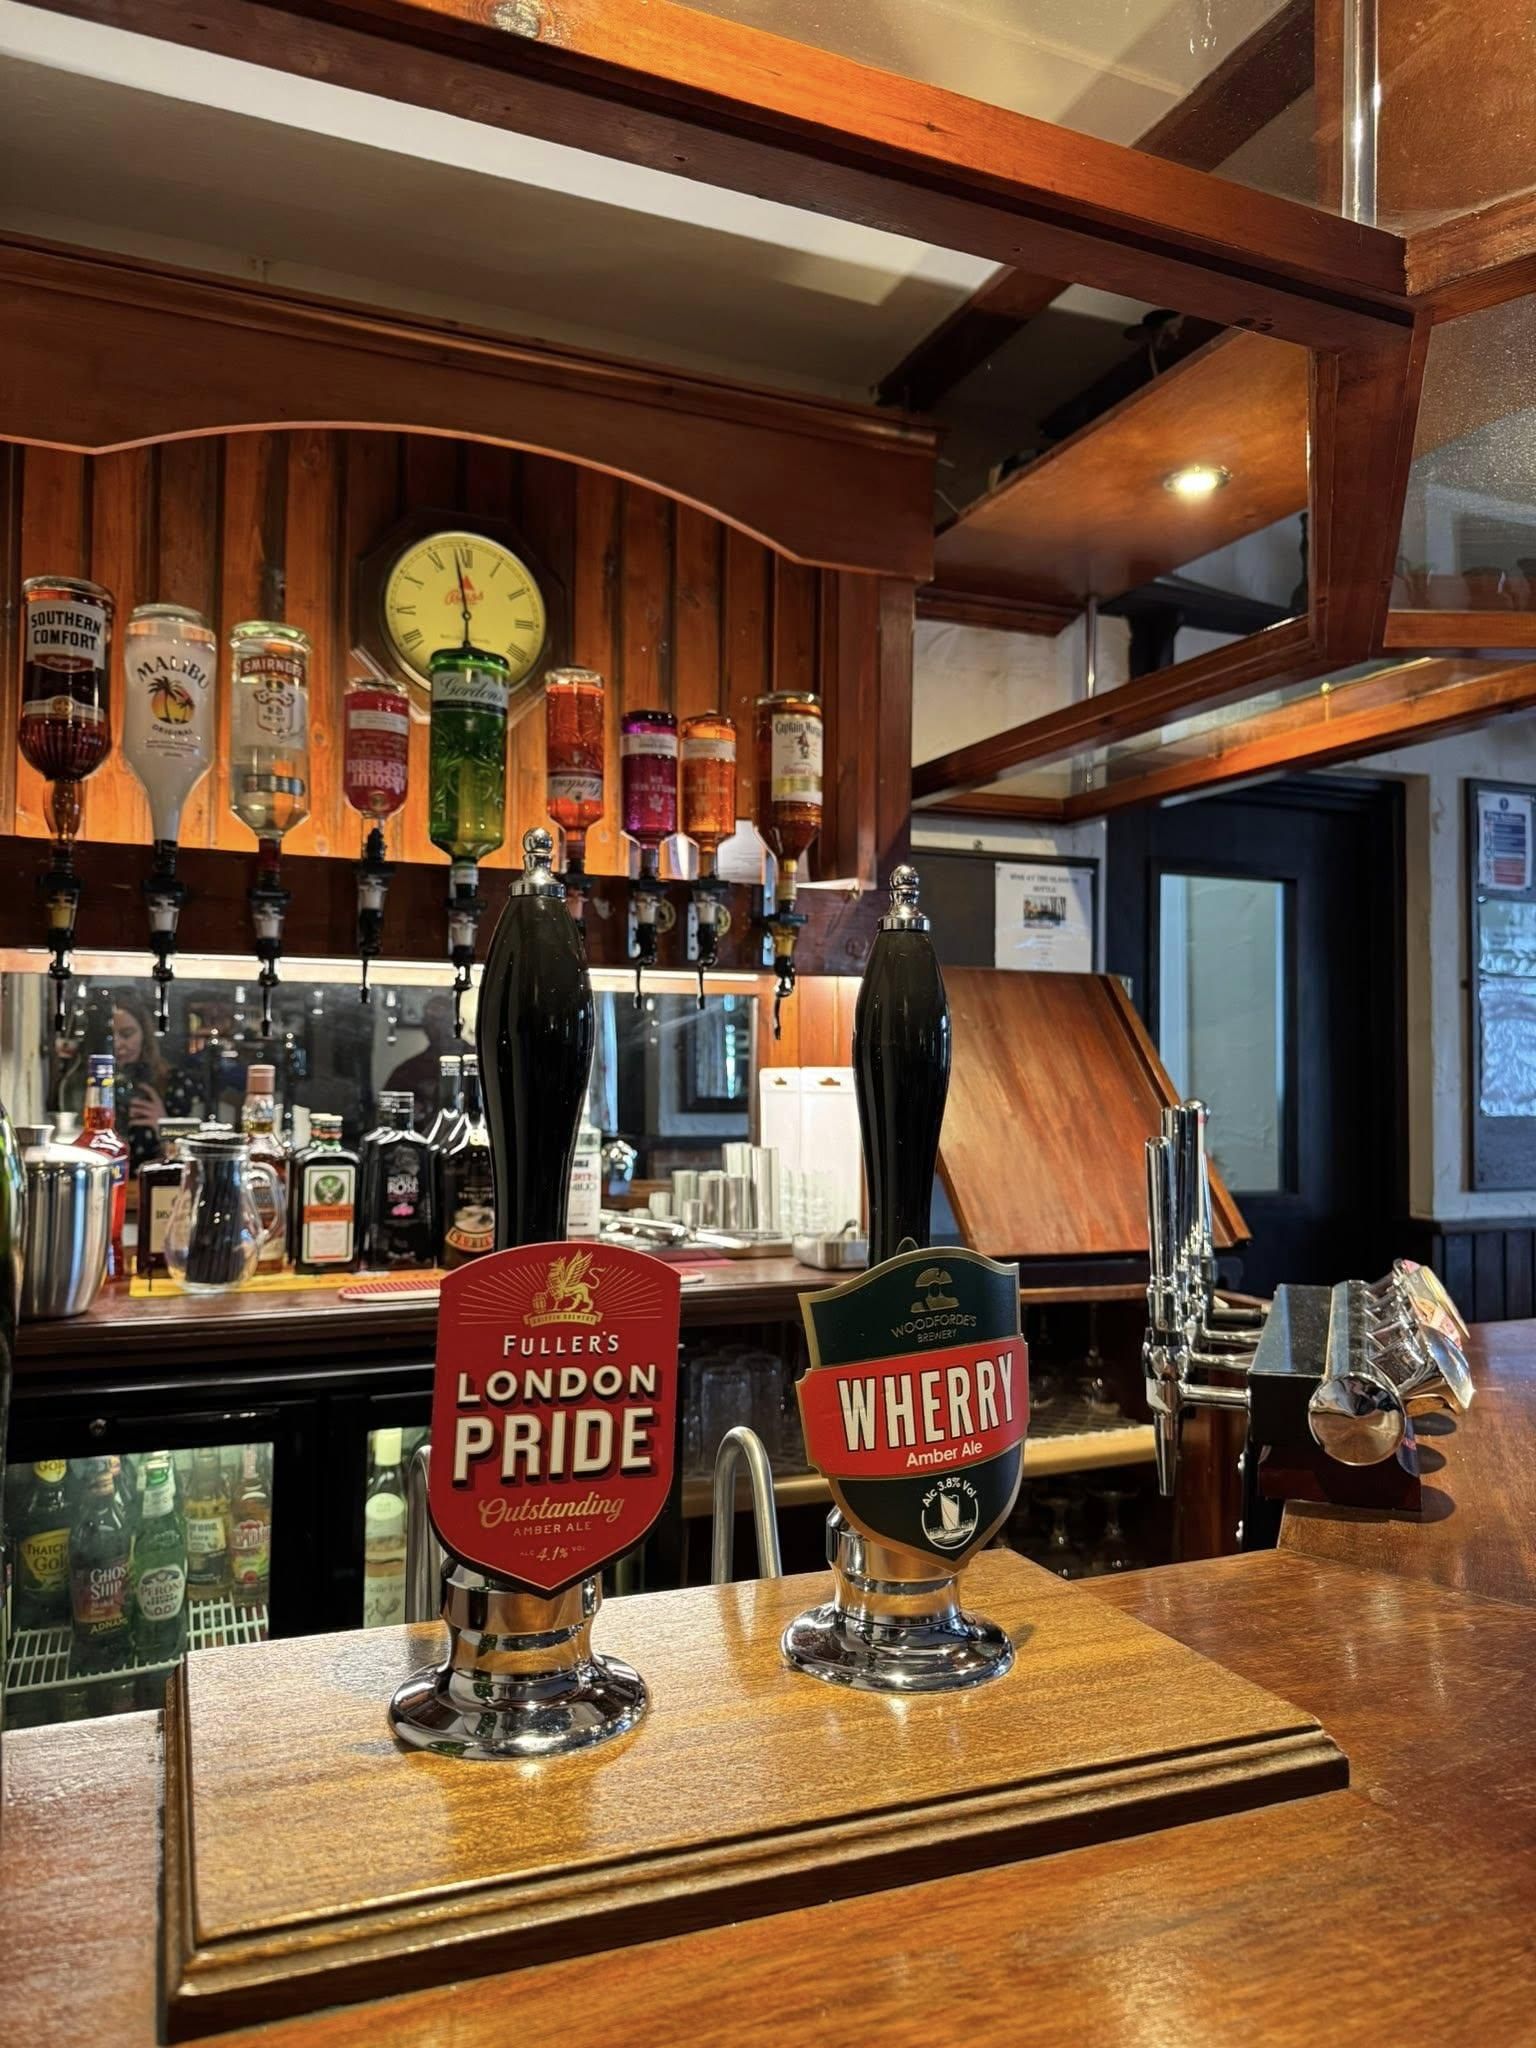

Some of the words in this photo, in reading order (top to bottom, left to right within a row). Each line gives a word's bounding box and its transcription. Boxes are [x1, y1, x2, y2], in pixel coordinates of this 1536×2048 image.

[31, 610, 101, 635] SOUTHERN
[33, 629, 96, 651] COMFORT
[136, 655, 209, 690] MALIBU
[917, 1329, 957, 1343] BREWERY
[457, 1364, 656, 1405] LONDON
[837, 1352, 1013, 1451] WHERRY
[452, 1407, 654, 1482] PRIDE
[906, 1448, 958, 1467] Amber
[961, 1440, 983, 1457] Ale
[922, 1489, 938, 1507] Alc
[937, 1477, 961, 1491] 3.8%
[962, 1480, 977, 1498] Vol
[478, 1491, 625, 1528] Outstanding
[513, 1523, 561, 1537] AMBER
[566, 1521, 593, 1533] ALE
[536, 1546, 568, 1561] 4.1%
[90, 1567, 127, 1584] GHOS
[91, 1581, 122, 1600] SHIP
